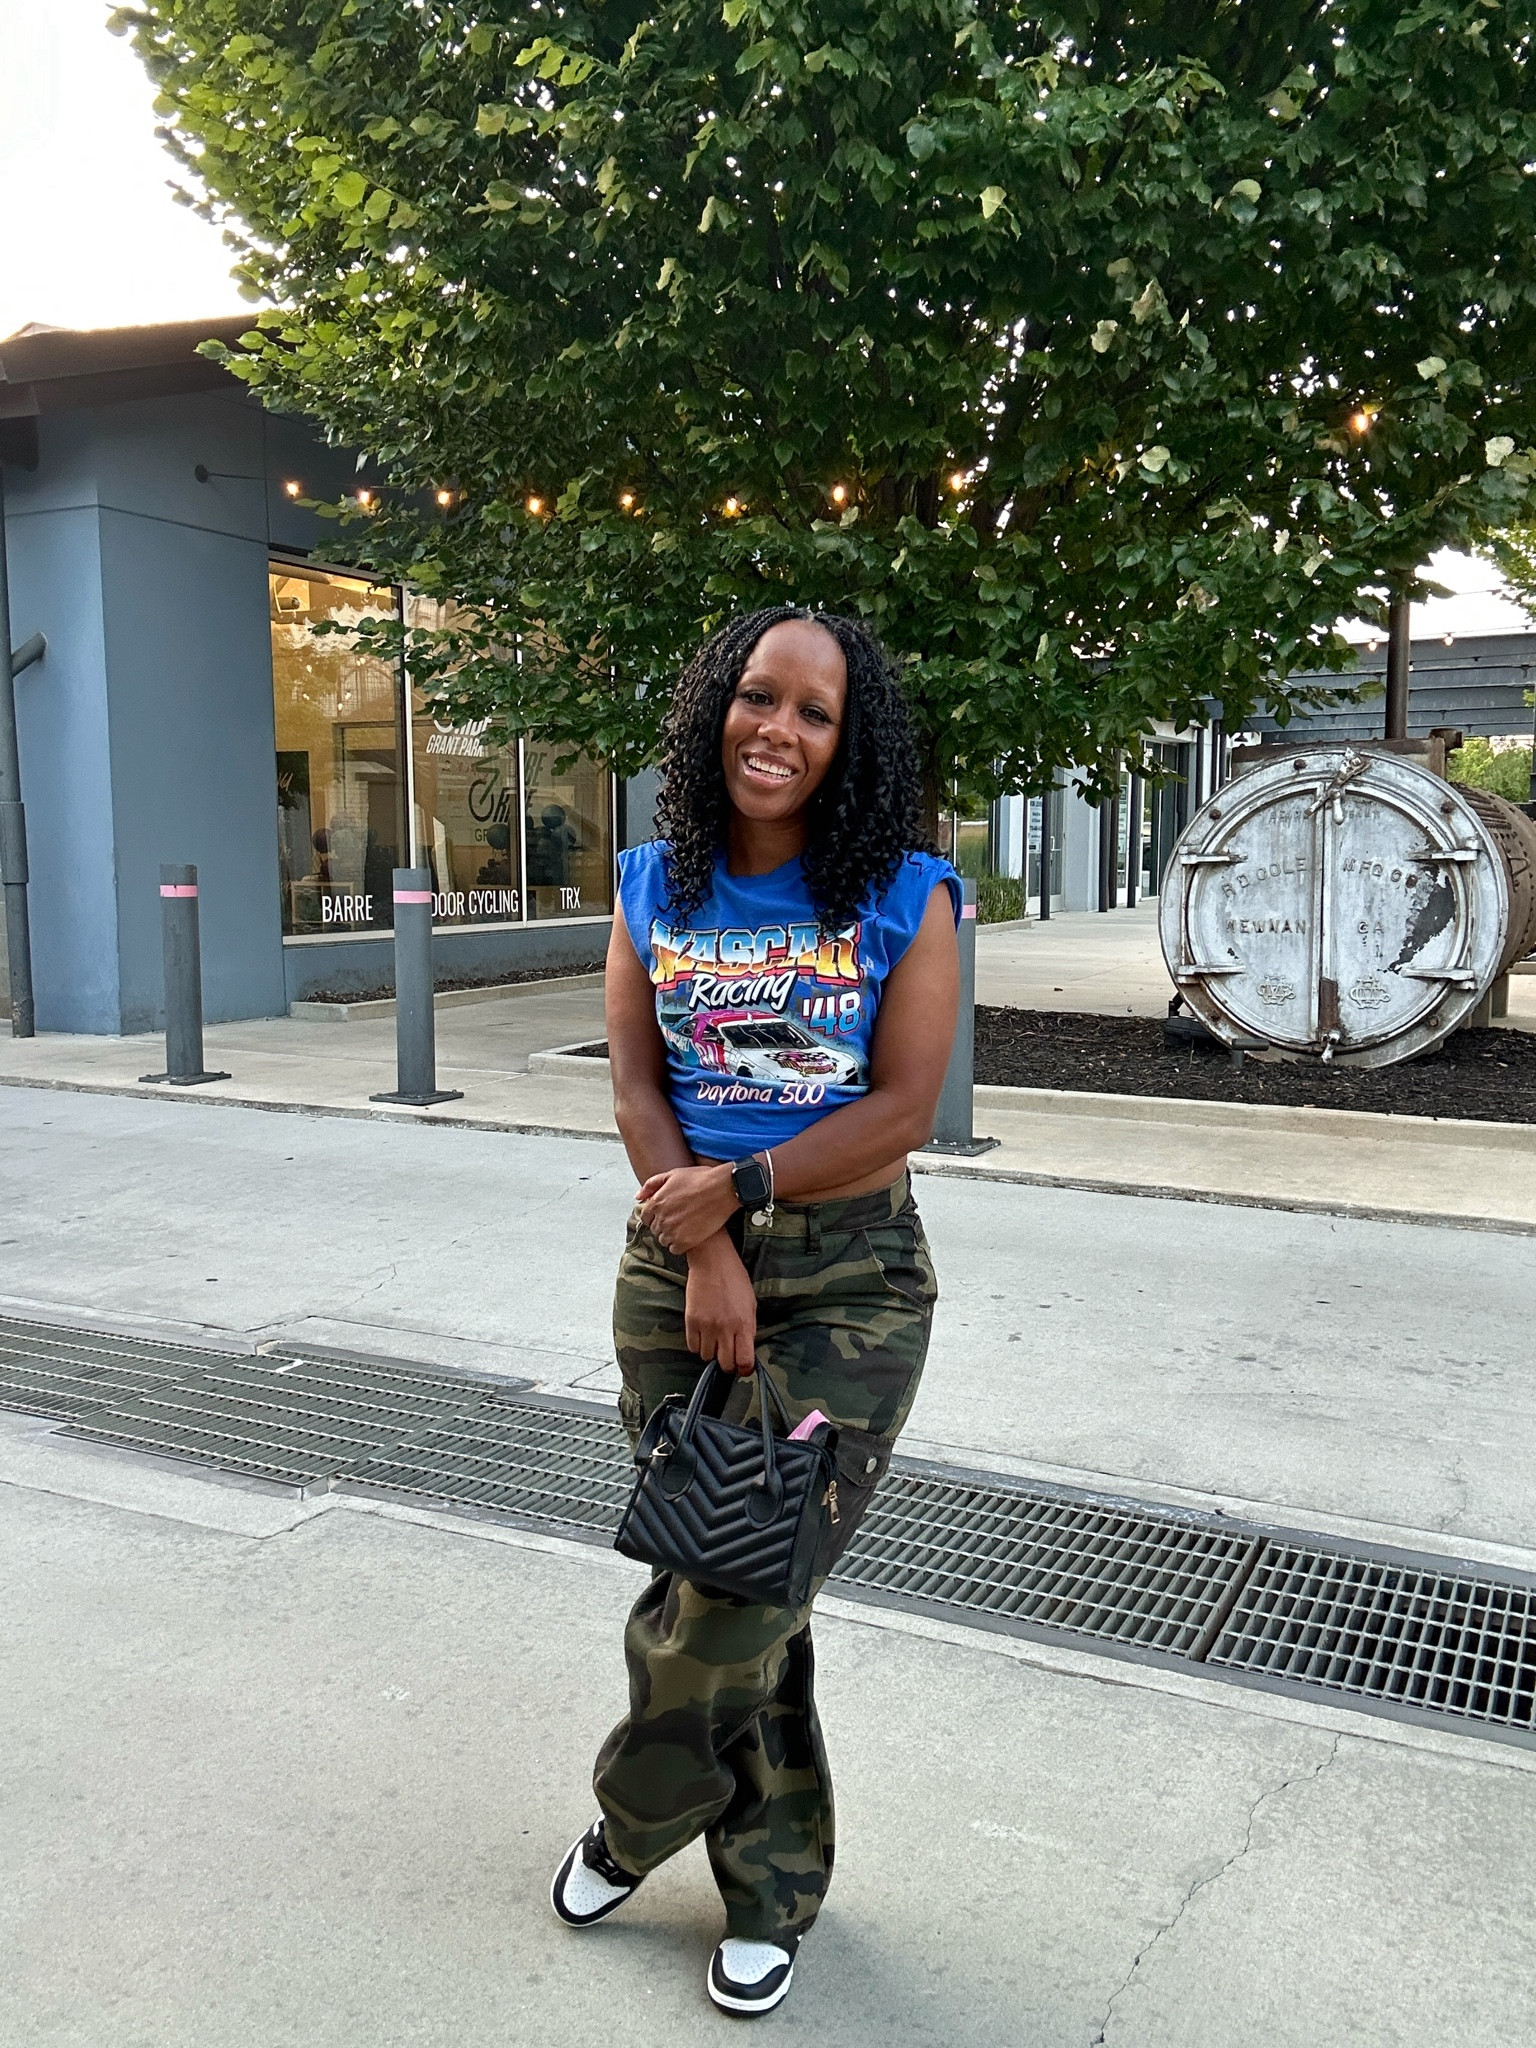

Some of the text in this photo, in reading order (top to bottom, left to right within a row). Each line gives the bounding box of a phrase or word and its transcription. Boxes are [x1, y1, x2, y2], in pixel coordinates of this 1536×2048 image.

[426, 734, 461, 755] GRANT
[322, 894, 374, 923] BARRE
[468, 889, 519, 915] CYCLING
[559, 886, 581, 910] TRX
[1225, 919, 1306, 935] NEWNAN
[651, 918, 864, 985] NASCAR
[688, 970, 797, 1010] Racing
[696, 1080, 825, 1106] Daytona 500
